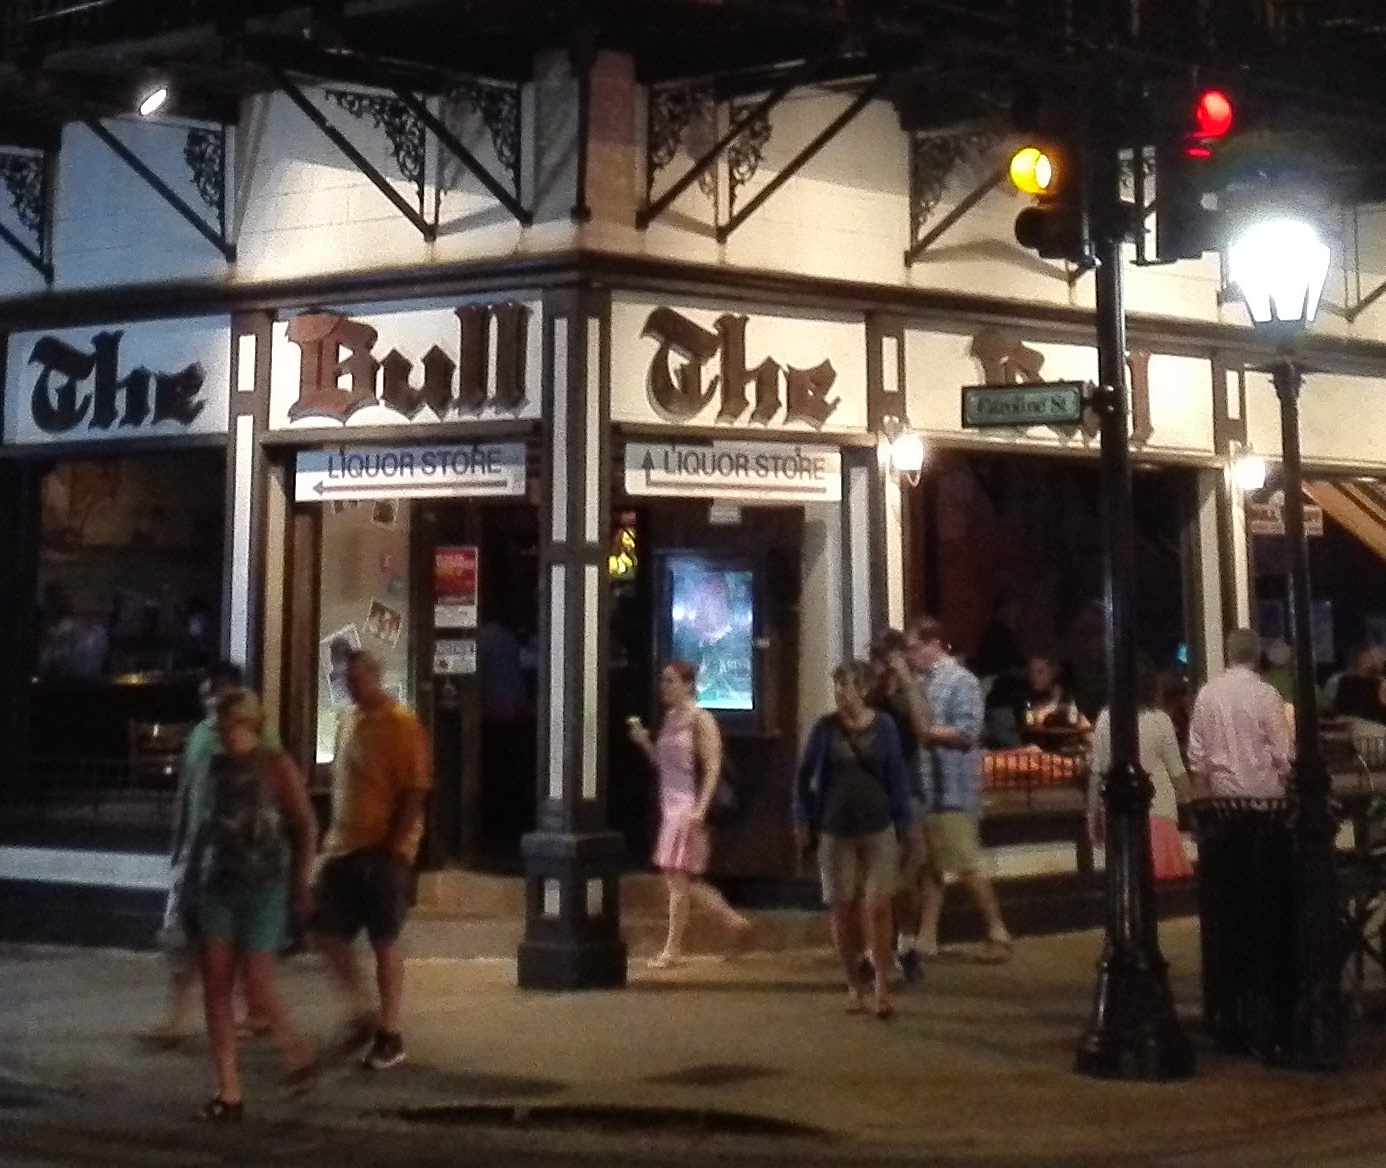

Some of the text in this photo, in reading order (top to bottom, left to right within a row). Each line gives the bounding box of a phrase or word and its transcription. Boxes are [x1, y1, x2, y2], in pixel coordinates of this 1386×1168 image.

[27, 330, 207, 432] The
[285, 302, 533, 427] Bull
[639, 306, 842, 432] The
[328, 445, 503, 479] LIQUOR STORE
[663, 449, 826, 481] LIQUOR STORE
